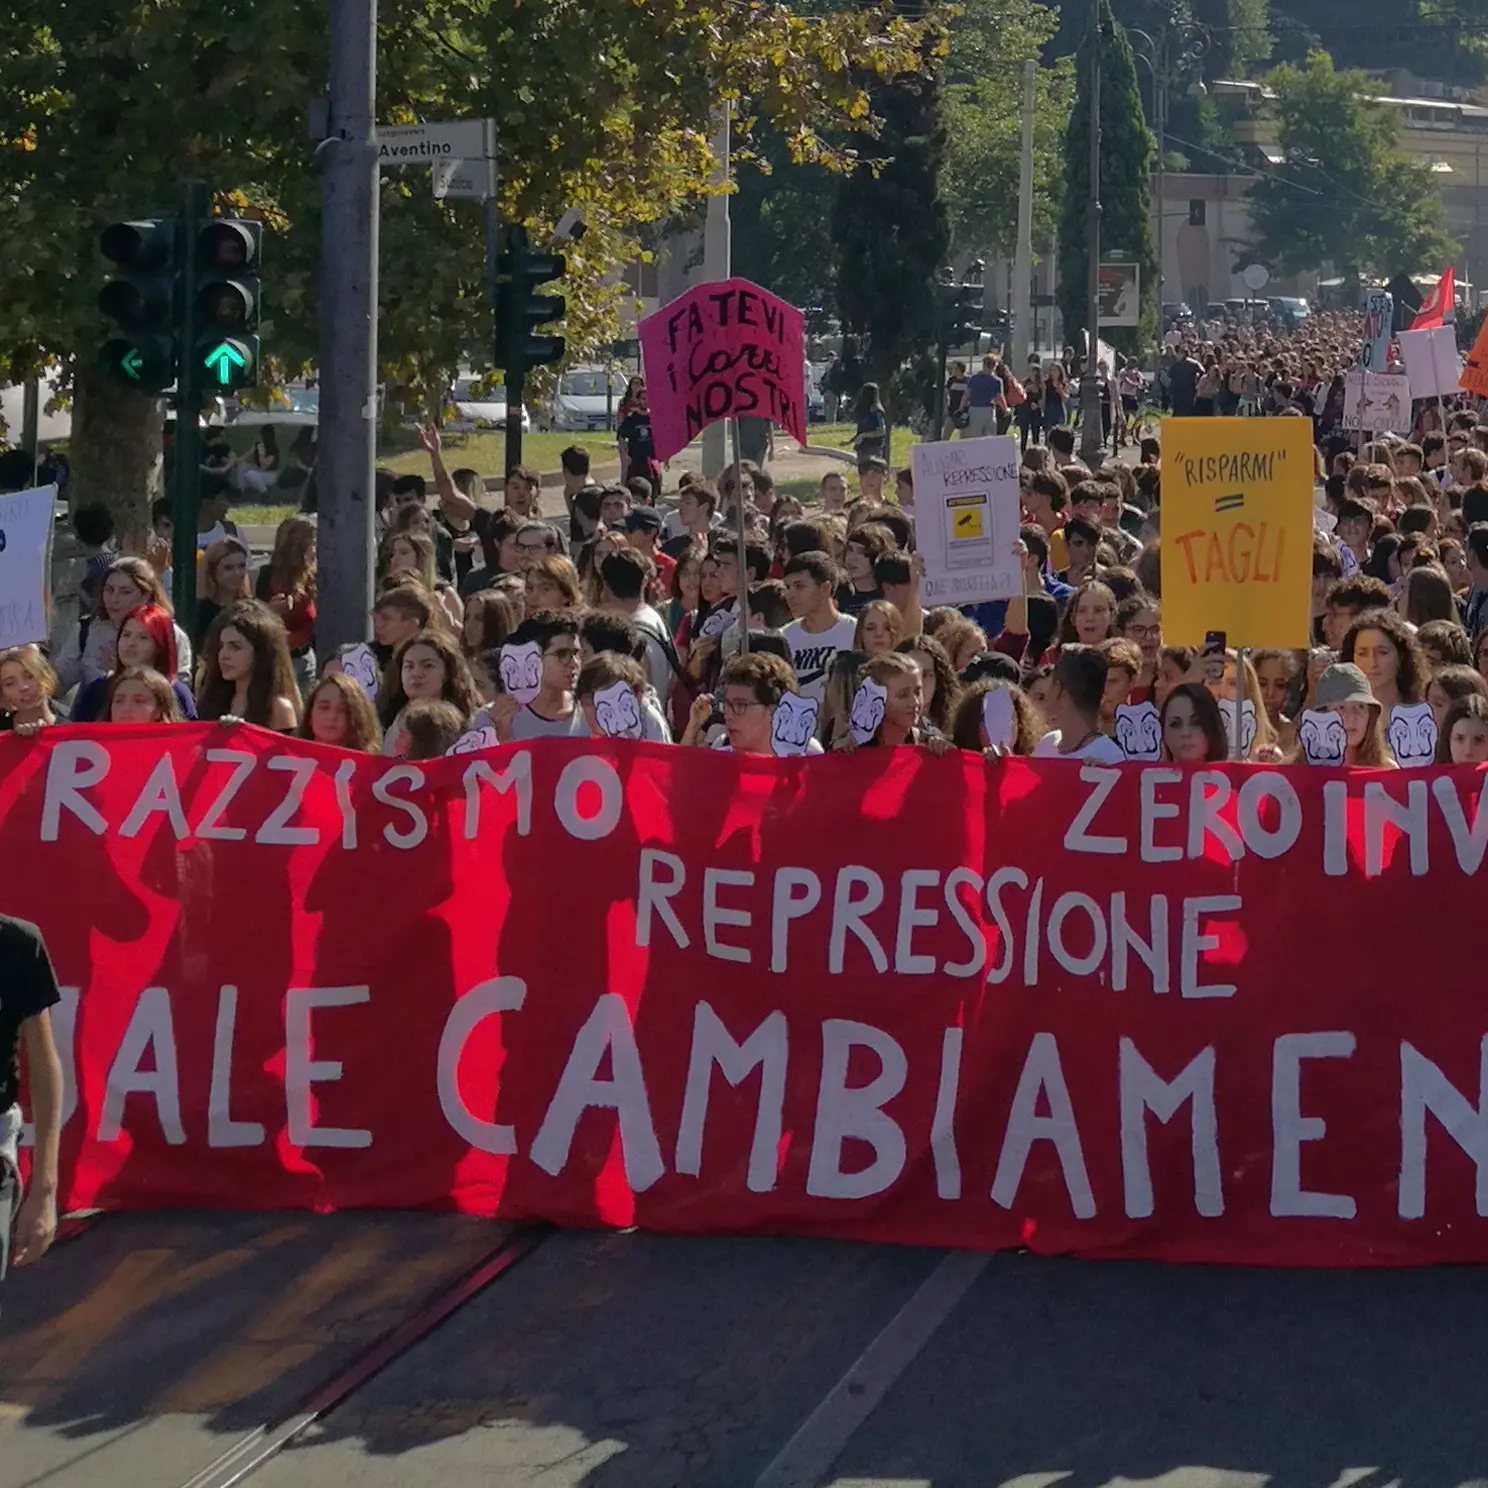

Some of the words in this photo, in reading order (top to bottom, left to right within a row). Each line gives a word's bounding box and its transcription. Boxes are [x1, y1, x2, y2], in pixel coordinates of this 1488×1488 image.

[379, 141, 452, 157] Aventino
[686, 372, 798, 442] NOSTRI
[1174, 449, 1286, 487] "RISPARMI"
[1175, 521, 1286, 584] TAGLI
[40, 739, 624, 850] RAZZISMO
[1063, 766, 1302, 863] ZERO
[635, 847, 1243, 998] REPRESSIONE
